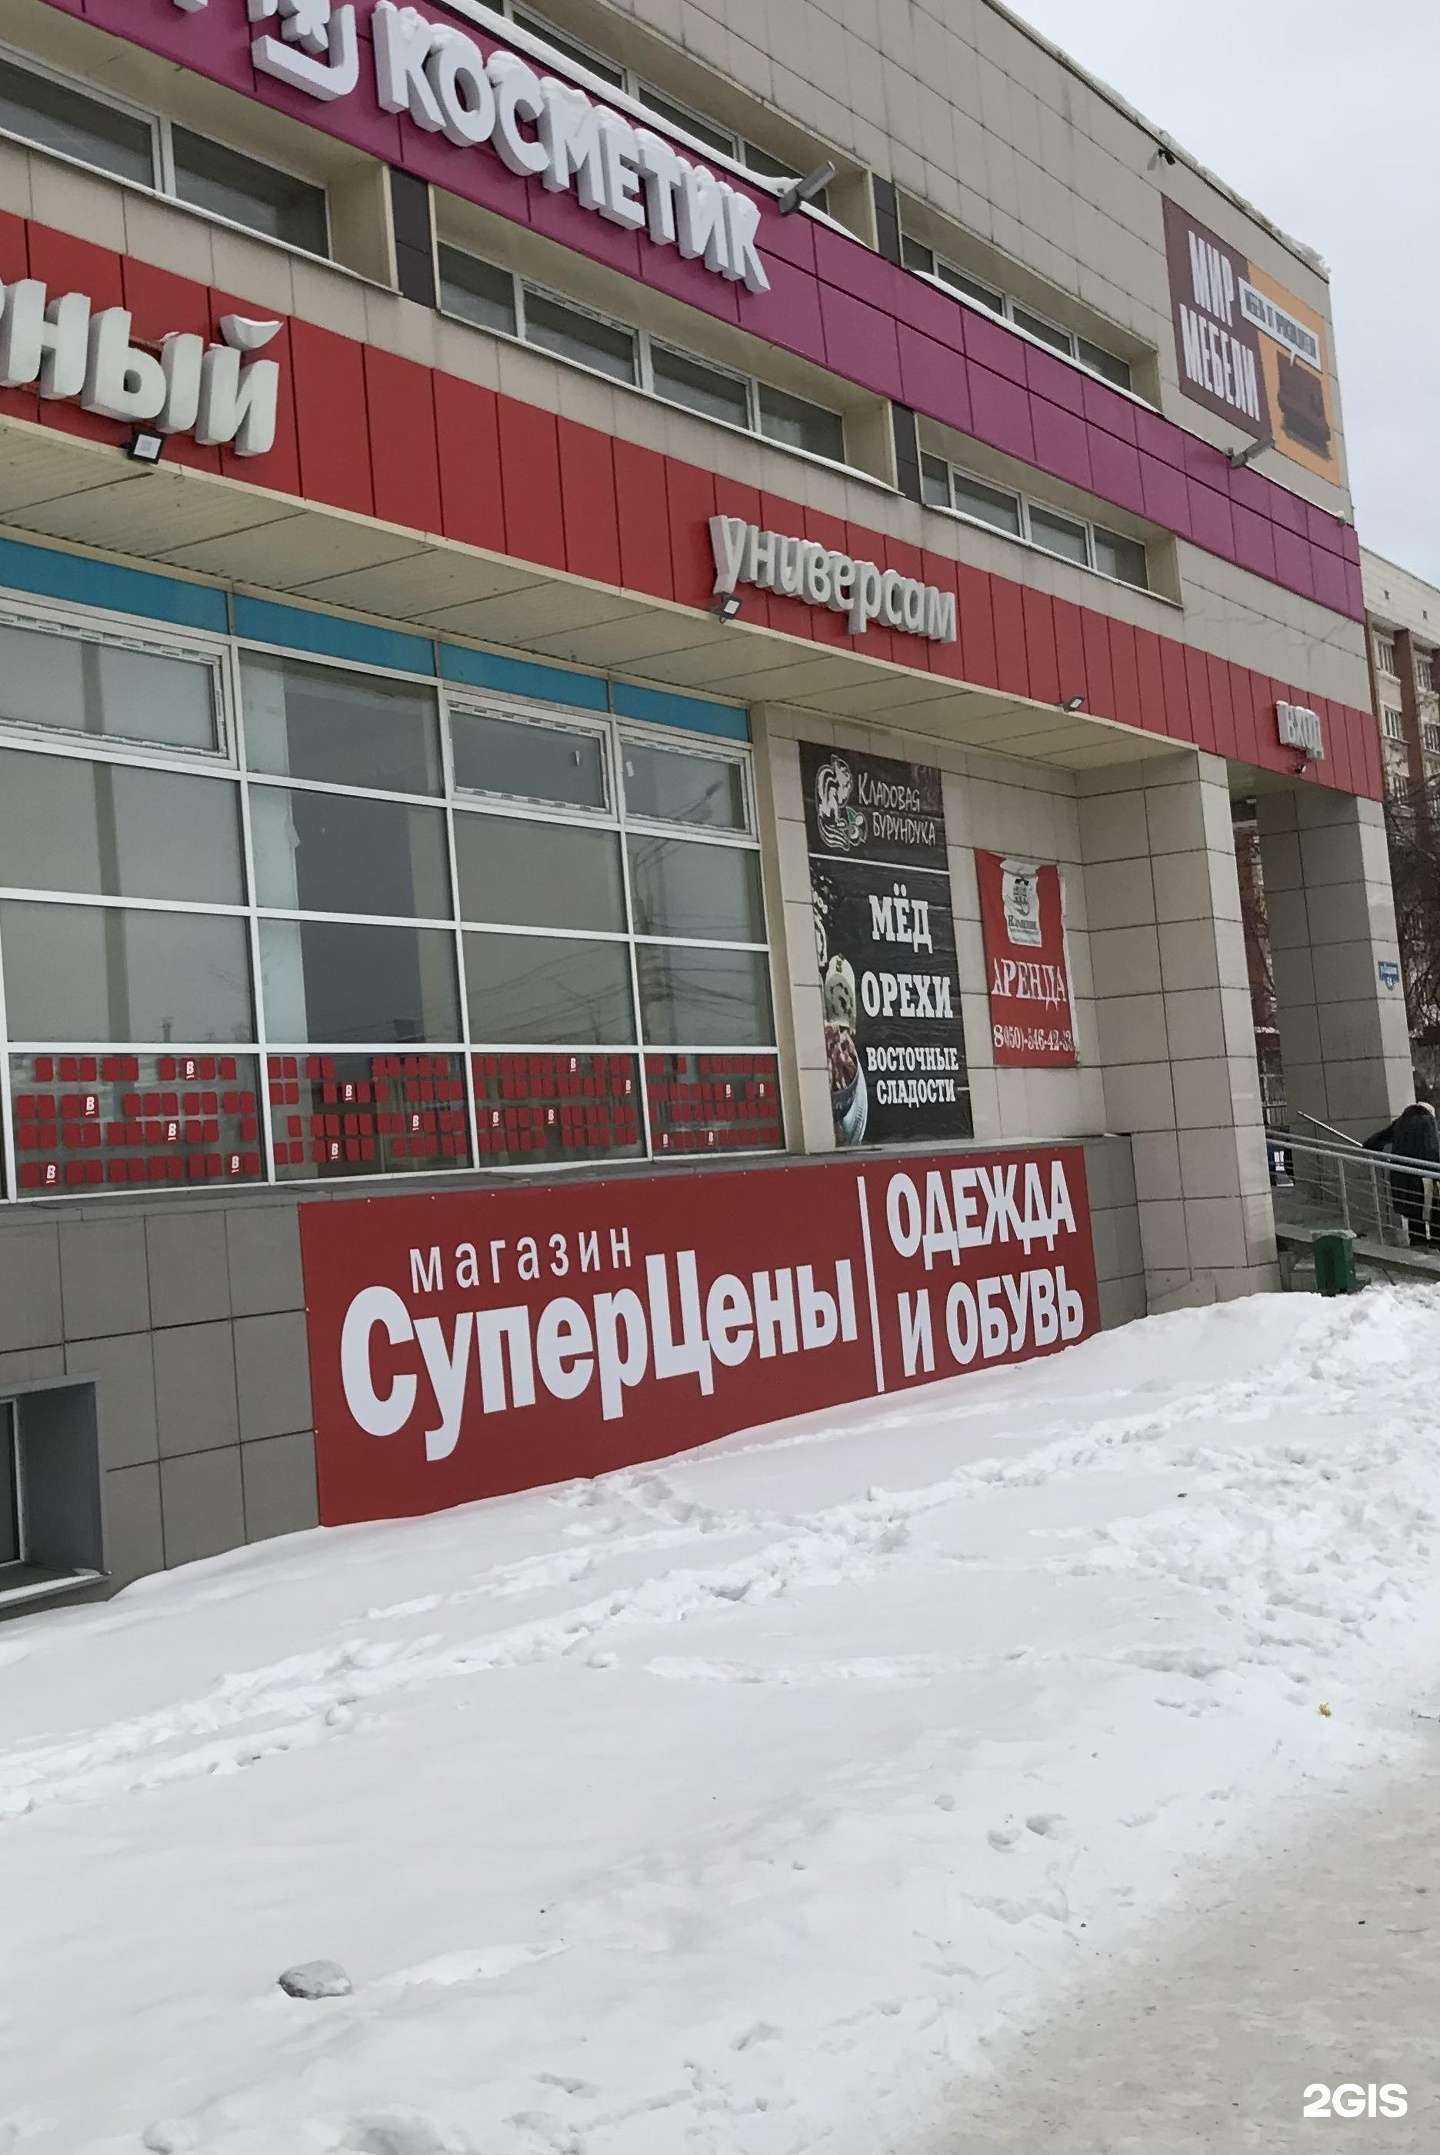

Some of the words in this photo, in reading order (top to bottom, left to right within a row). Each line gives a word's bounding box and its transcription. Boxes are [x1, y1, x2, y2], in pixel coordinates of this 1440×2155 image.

[371, 0, 771, 294] КОСМЕТИК
[1188, 230, 1234, 328] МИР
[0, 278, 284, 458] ный
[1179, 302, 1261, 422] МЕБЕЛИ
[872, 811, 936, 846] БУРУНДУКА
[869, 883, 934, 954] МЁД
[861, 972, 954, 1019] ОРЕХИ
[991, 957, 1067, 1012] АРЕНДА
[866, 1046, 959, 1073] ВОСТОЧНЫЕ
[876, 1077, 957, 1108] СЛАДОСТИ
[885, 1160, 1077, 1270] ОДЕЖДА
[410, 1226, 631, 1293] магазин
[340, 1249, 858, 1462] СуперЦены
[897, 1289, 935, 1377] И
[945, 1264, 1085, 1366] ОБУВЬ
